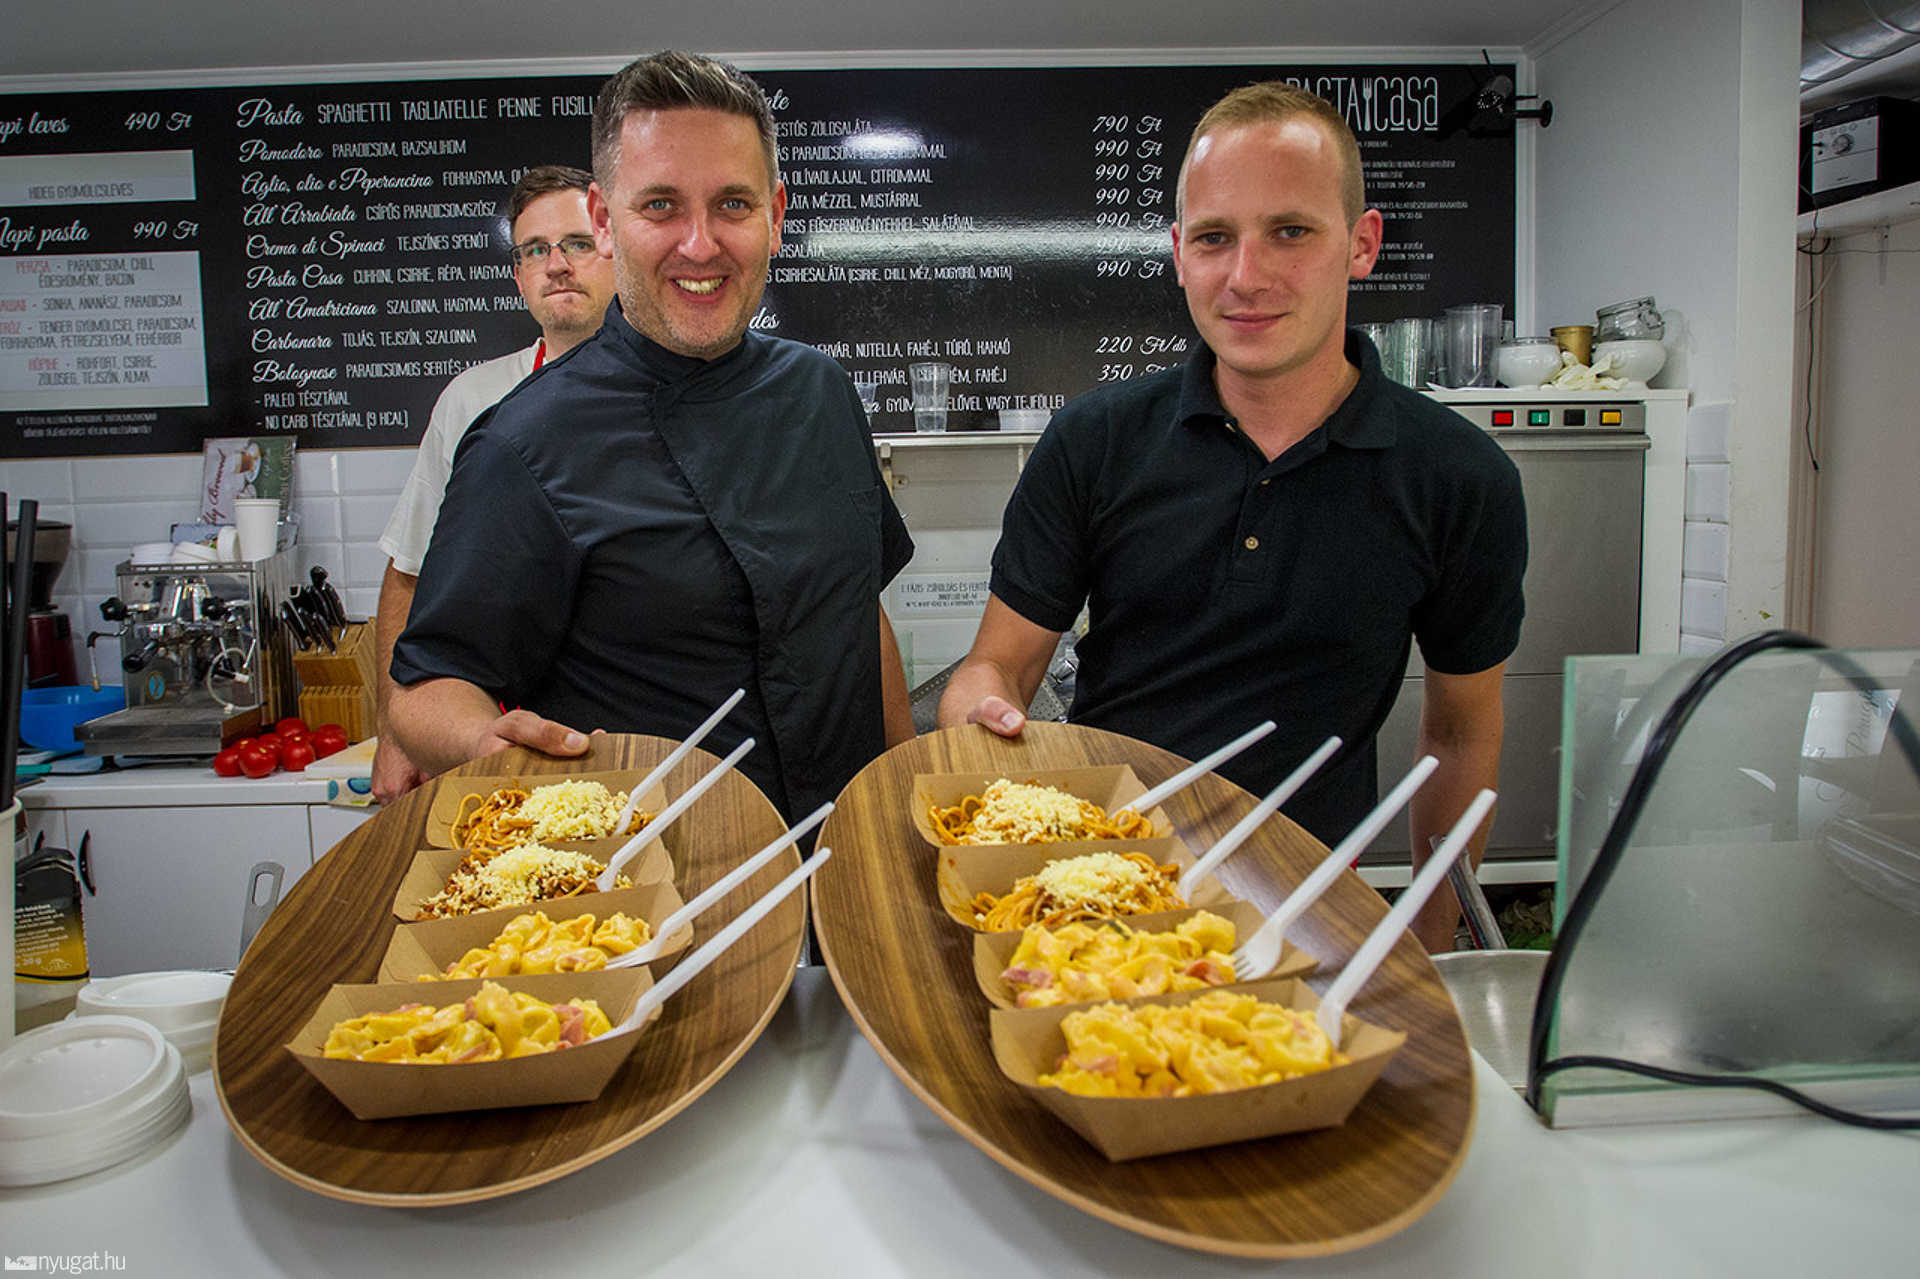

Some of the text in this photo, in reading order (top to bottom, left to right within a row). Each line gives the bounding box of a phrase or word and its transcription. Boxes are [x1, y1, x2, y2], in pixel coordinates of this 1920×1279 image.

[236, 98, 304, 128] Pasta
[317, 102, 391, 124] SPAGHETTI
[401, 99, 488, 120] TAGLIATELLE
[498, 97, 542, 118] PENNE
[0, 111, 193, 143] api leves 490 Ft
[775, 120, 808, 137] ESTÓS
[1093, 115, 1162, 134] 790 Ft
[239, 139, 324, 163] Pomodoro
[1095, 139, 1162, 159] 990 Ft
[296, 173, 325, 192] olio
[328, 179, 339, 191] e
[339, 167, 434, 196] Peperoncino
[870, 168, 934, 184] CITROMMAL
[1095, 163, 1130, 181] 990
[1137, 164, 1163, 183] Ft
[861, 191, 922, 208] MUSTÁRRAL
[1096, 188, 1163, 207] 990 Ft
[281, 201, 358, 225] Arrabiata
[403, 199, 497, 219] PARADICSOMSZÓSZ
[1096, 212, 1164, 231] 990 Ft
[36, 219, 91, 251] pasta
[134, 221, 168, 239] 990
[172, 220, 200, 240] Ft
[783, 219, 806, 235] RISS
[246, 231, 490, 260] Crema di Spinaci TEJSZÍNES SPENÓT
[246, 265, 298, 289] Pasta
[302, 264, 344, 289] Casa
[1097, 260, 1131, 277] 990
[1138, 260, 1165, 279] Ft
[286, 296, 378, 320] Amatriciana
[749, 307, 780, 329] des
[251, 328, 334, 353] Carbonara
[425, 328, 478, 345] SZALONNA
[1095, 336, 1133, 353] 220
[1140, 335, 1187, 355] Ft/db
[252, 360, 338, 388] Bolognese
[345, 361, 421, 379] PARADICSOMOS
[976, 366, 1007, 384] FAHÉJ
[1098, 364, 1133, 382] 350
[264, 392, 294, 408] PALEO
[298, 389, 351, 408] TÉSZTÁVAL
[985, 396, 1011, 411] VAGY
[265, 414, 280, 430] NO
[281, 413, 308, 430] CARB
[311, 410, 363, 428] TÉSZTÁVAL
